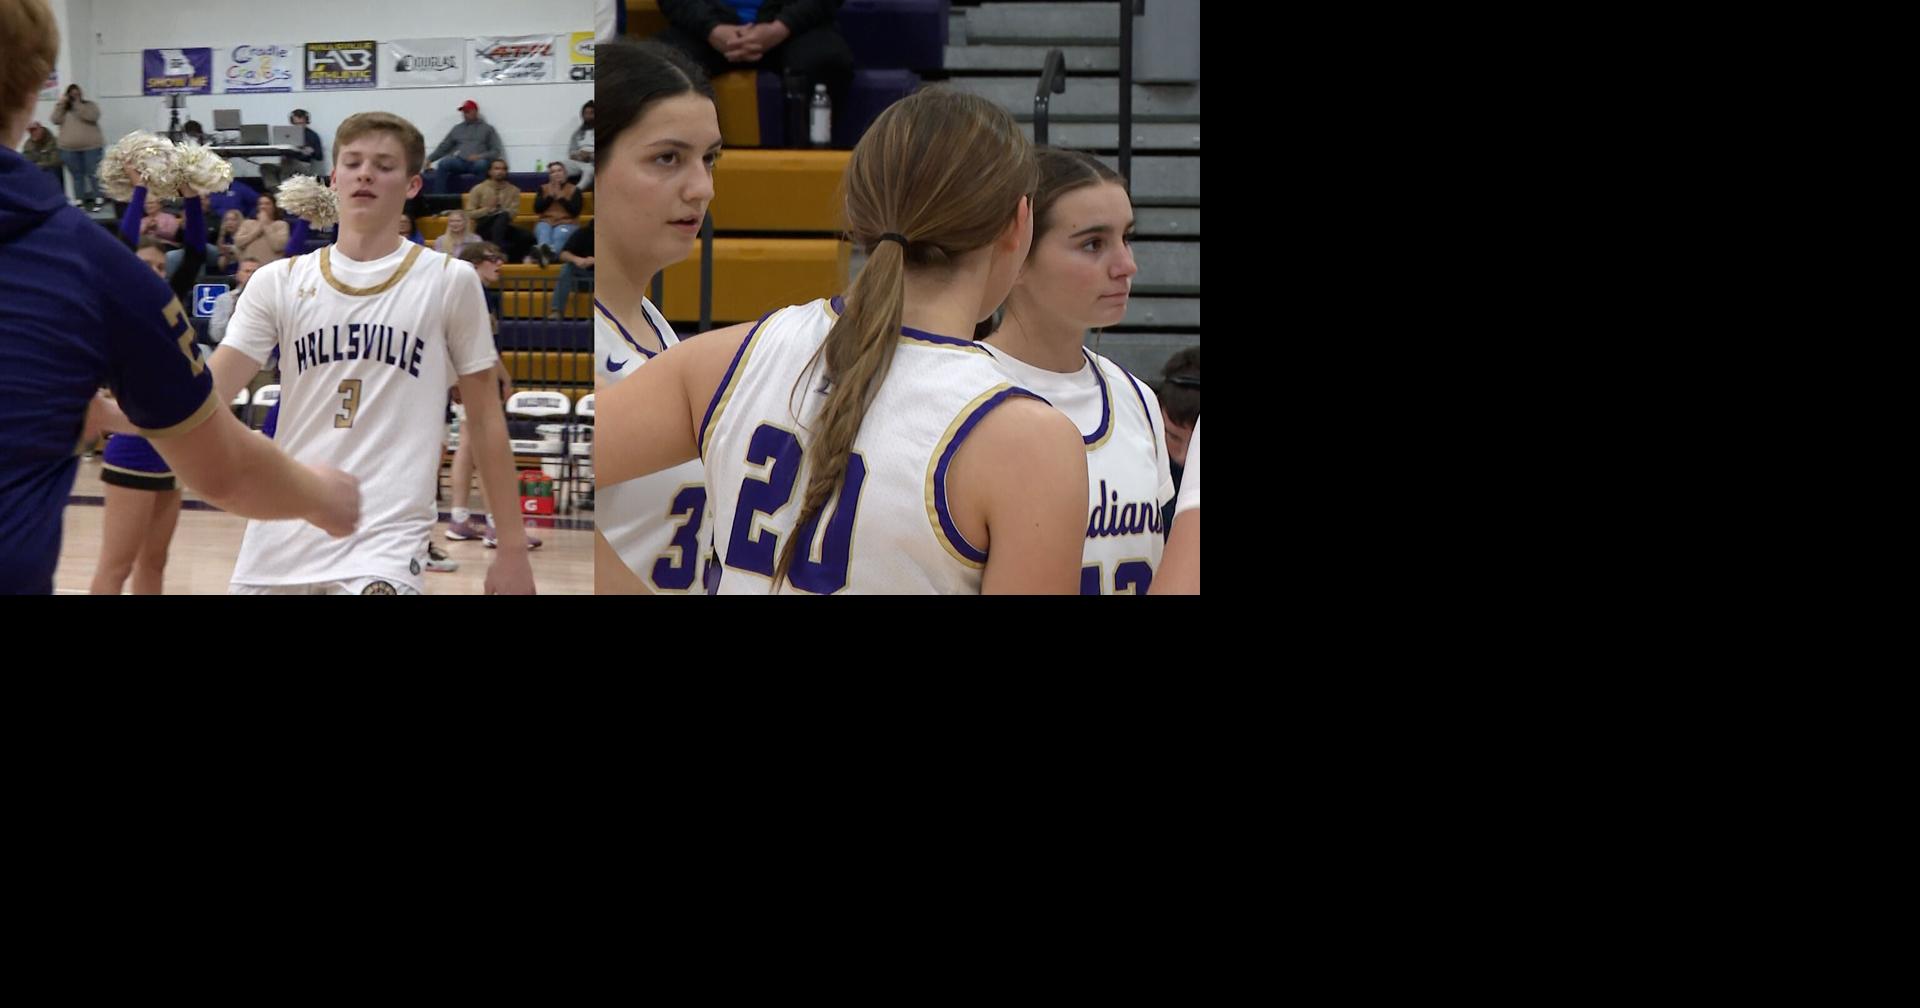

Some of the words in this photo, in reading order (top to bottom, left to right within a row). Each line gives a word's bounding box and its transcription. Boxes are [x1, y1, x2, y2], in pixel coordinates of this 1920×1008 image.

[232, 44, 288, 64] Cradle
[294, 322, 425, 377] HALLSVILLE
[334, 379, 362, 428] 3
[524, 499, 538, 512] G
[724, 419, 870, 596] 20
[648, 482, 716, 593] 3
